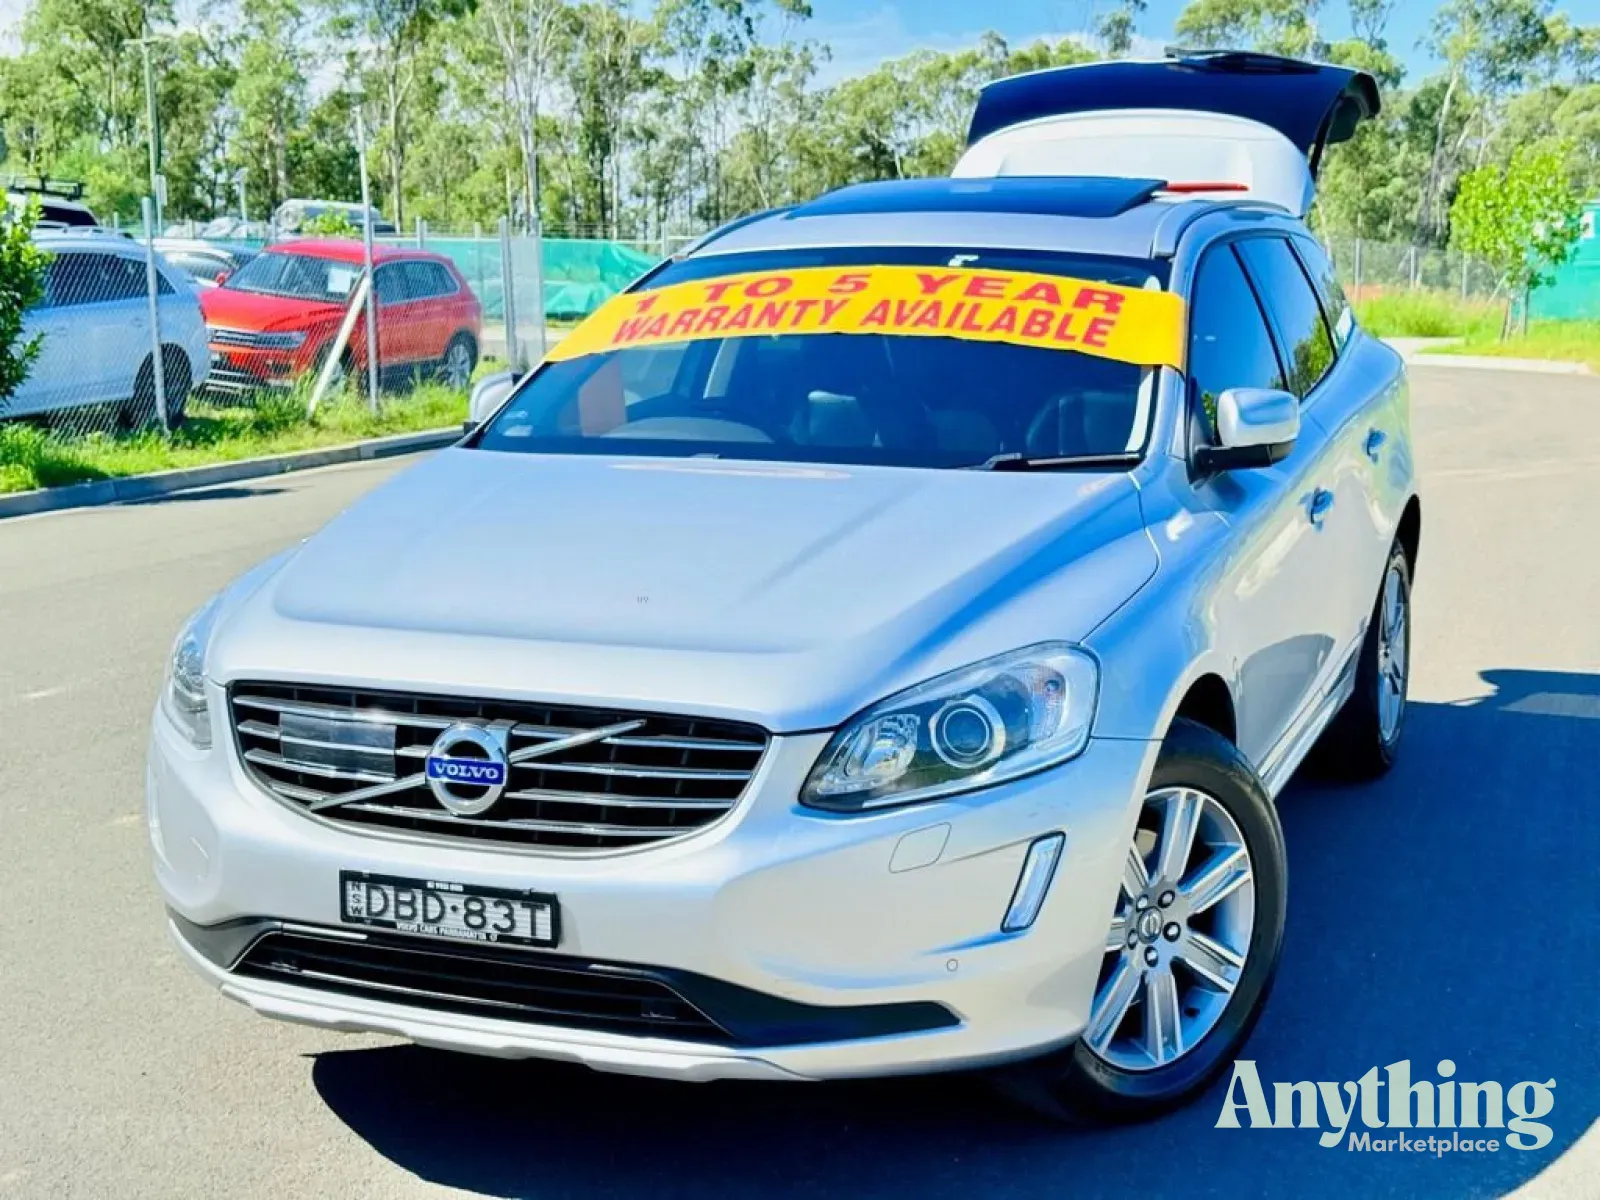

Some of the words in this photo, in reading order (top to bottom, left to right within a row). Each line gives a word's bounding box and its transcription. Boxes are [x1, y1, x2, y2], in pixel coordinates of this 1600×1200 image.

[636, 295, 660, 313] 1
[703, 277, 793, 302] TO
[828, 274, 872, 294] 5
[916, 274, 1125, 314] YEAR
[612, 299, 850, 344] WARRANTY
[859, 300, 1116, 348] AVAILABLE
[432, 762, 499, 779] VOLVO
